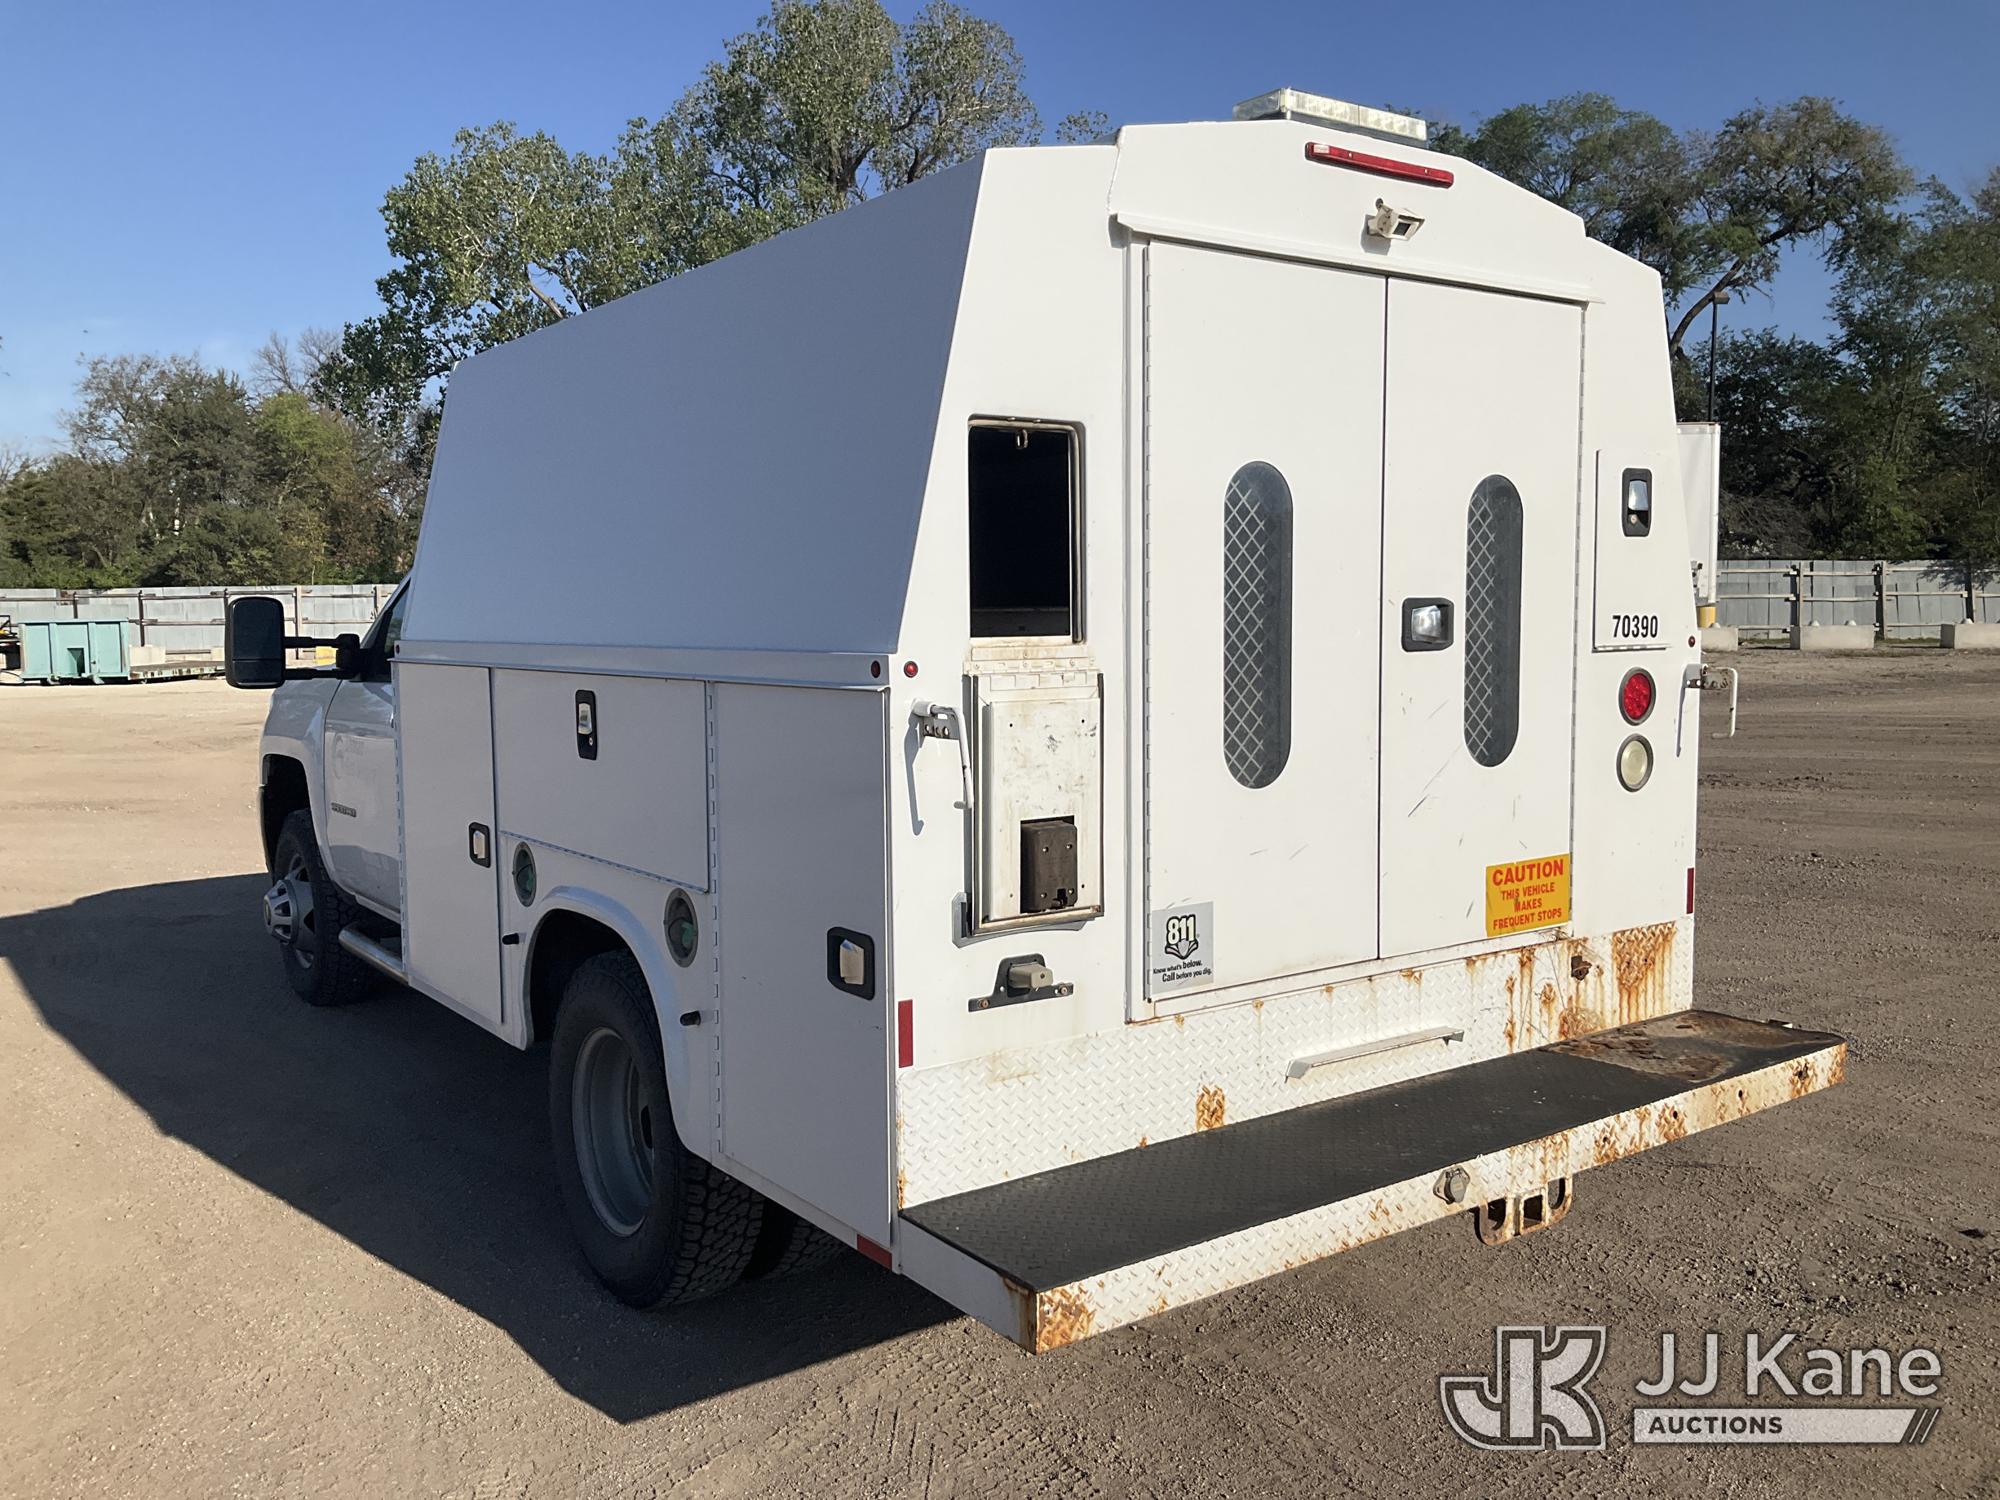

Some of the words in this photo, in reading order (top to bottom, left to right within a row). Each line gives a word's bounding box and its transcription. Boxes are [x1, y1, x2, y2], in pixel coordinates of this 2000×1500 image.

[1612, 614, 1658, 638] 70390
[1493, 859, 1564, 886] CAUTION
[1501, 888, 1520, 900] THIS
[1522, 882, 1555, 897] VEHICLE
[1514, 898, 1542, 912] MAKES
[1493, 912, 1535, 930] FREQUENT
[1537, 908, 1562, 921] STOPS
[1166, 914, 1196, 945] 811
[1162, 973, 1175, 982] Call
[1176, 970, 1192, 980] before
[1192, 969, 1202, 978] you
[1202, 967, 1212, 976] dig.
[1167, 963, 1182, 972] what's
[1182, 960, 1203, 969] below.
